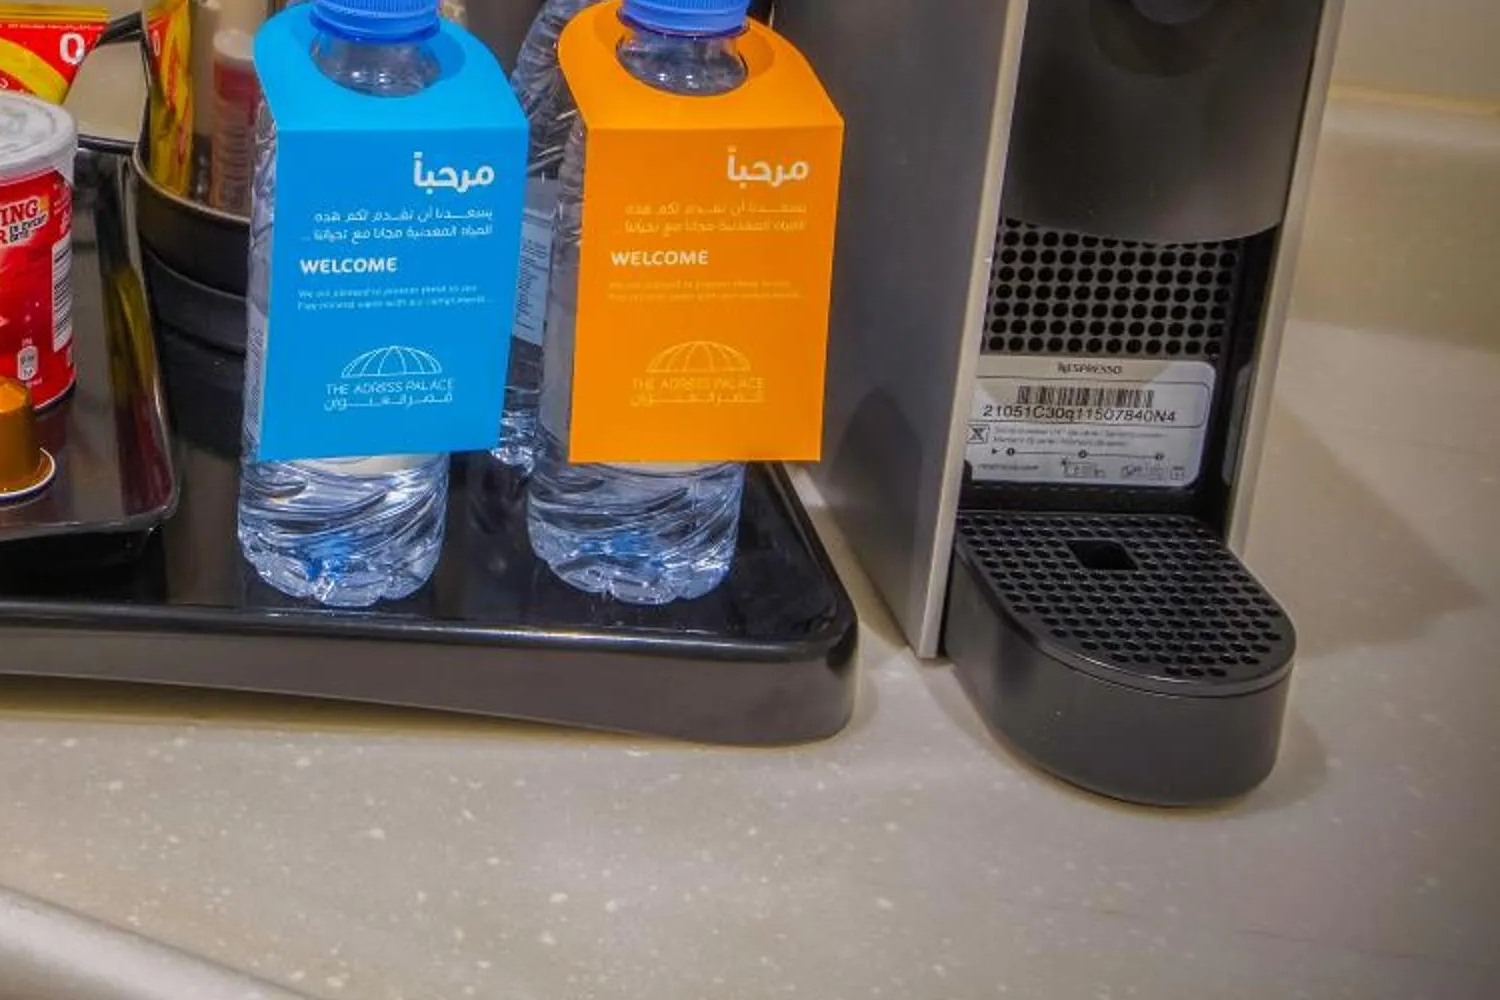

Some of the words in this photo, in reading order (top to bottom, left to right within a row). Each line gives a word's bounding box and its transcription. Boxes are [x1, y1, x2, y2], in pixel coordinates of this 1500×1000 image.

[300, 257, 399, 275] WELCOME
[611, 250, 709, 266] WELCOME
[325, 383, 350, 395] THE
[405, 378, 454, 391] PALACE
